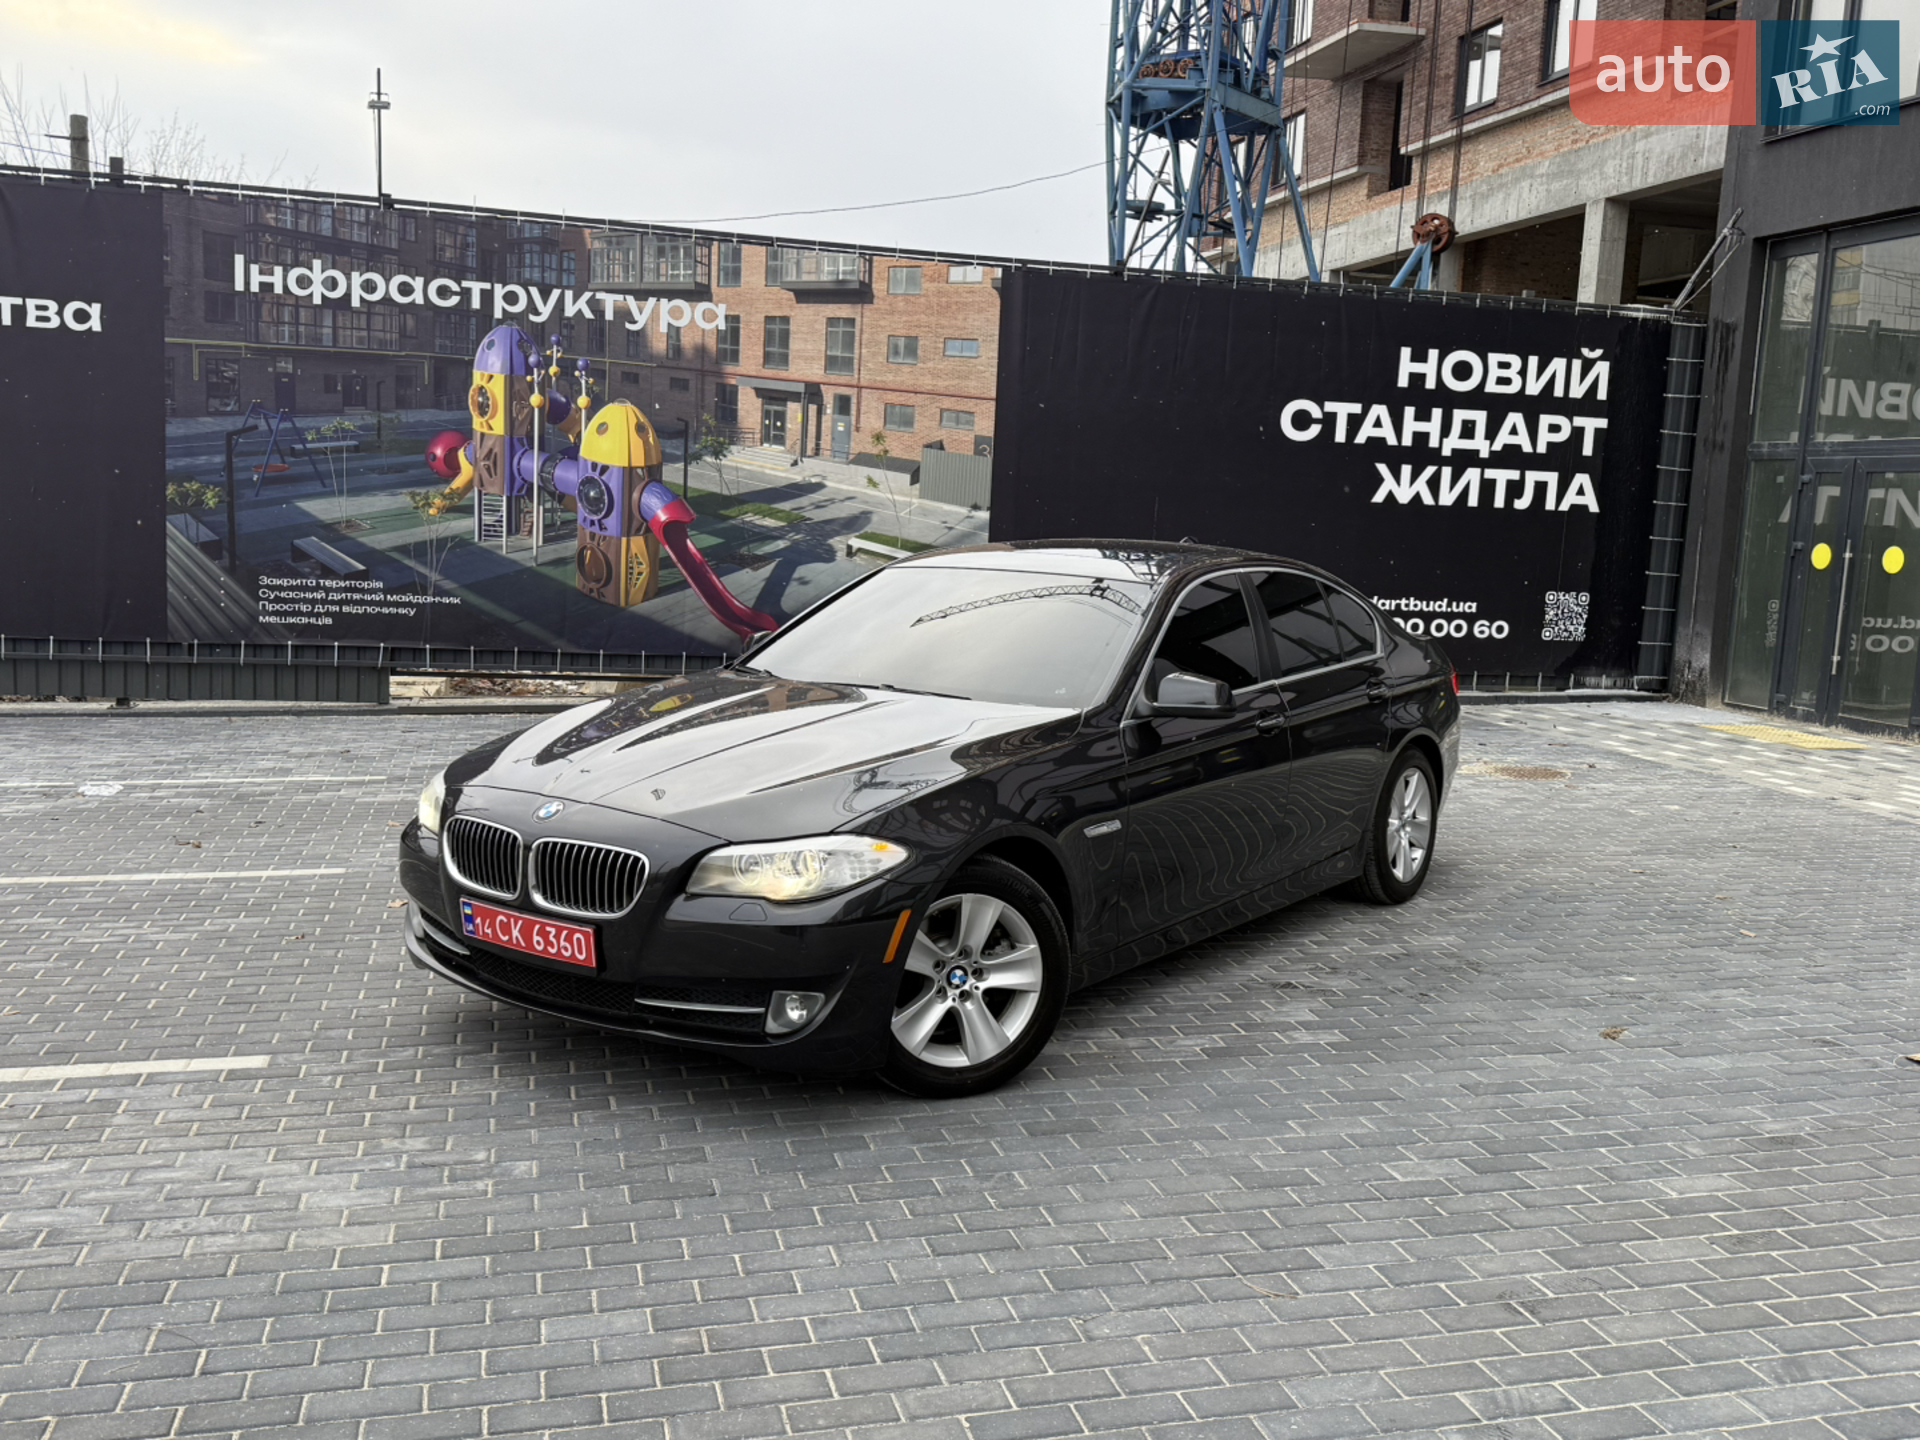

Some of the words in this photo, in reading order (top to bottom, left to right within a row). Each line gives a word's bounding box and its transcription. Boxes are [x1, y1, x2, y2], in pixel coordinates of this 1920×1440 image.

[233, 253, 727, 333] Інфраструктура
[1397, 346, 1610, 401] НОВИЙ
[1280, 399, 1608, 459] СТАНДАРТ
[1371, 462, 1600, 513] ЖИТЛА
[258, 576, 316, 587] Закрита
[319, 578, 383, 589] територія
[258, 588, 326, 601] Сучасний
[328, 590, 384, 602] дитячий
[387, 594, 461, 605] майданчик
[258, 616, 333, 625] мешканців
[259, 601, 312, 613] Простір
[314, 604, 339, 614] для
[342, 606, 417, 616] відпочинку
[1430, 618, 1468, 638] 00
[1473, 620, 1509, 639] 60
[532, 924, 586, 961] 6360
